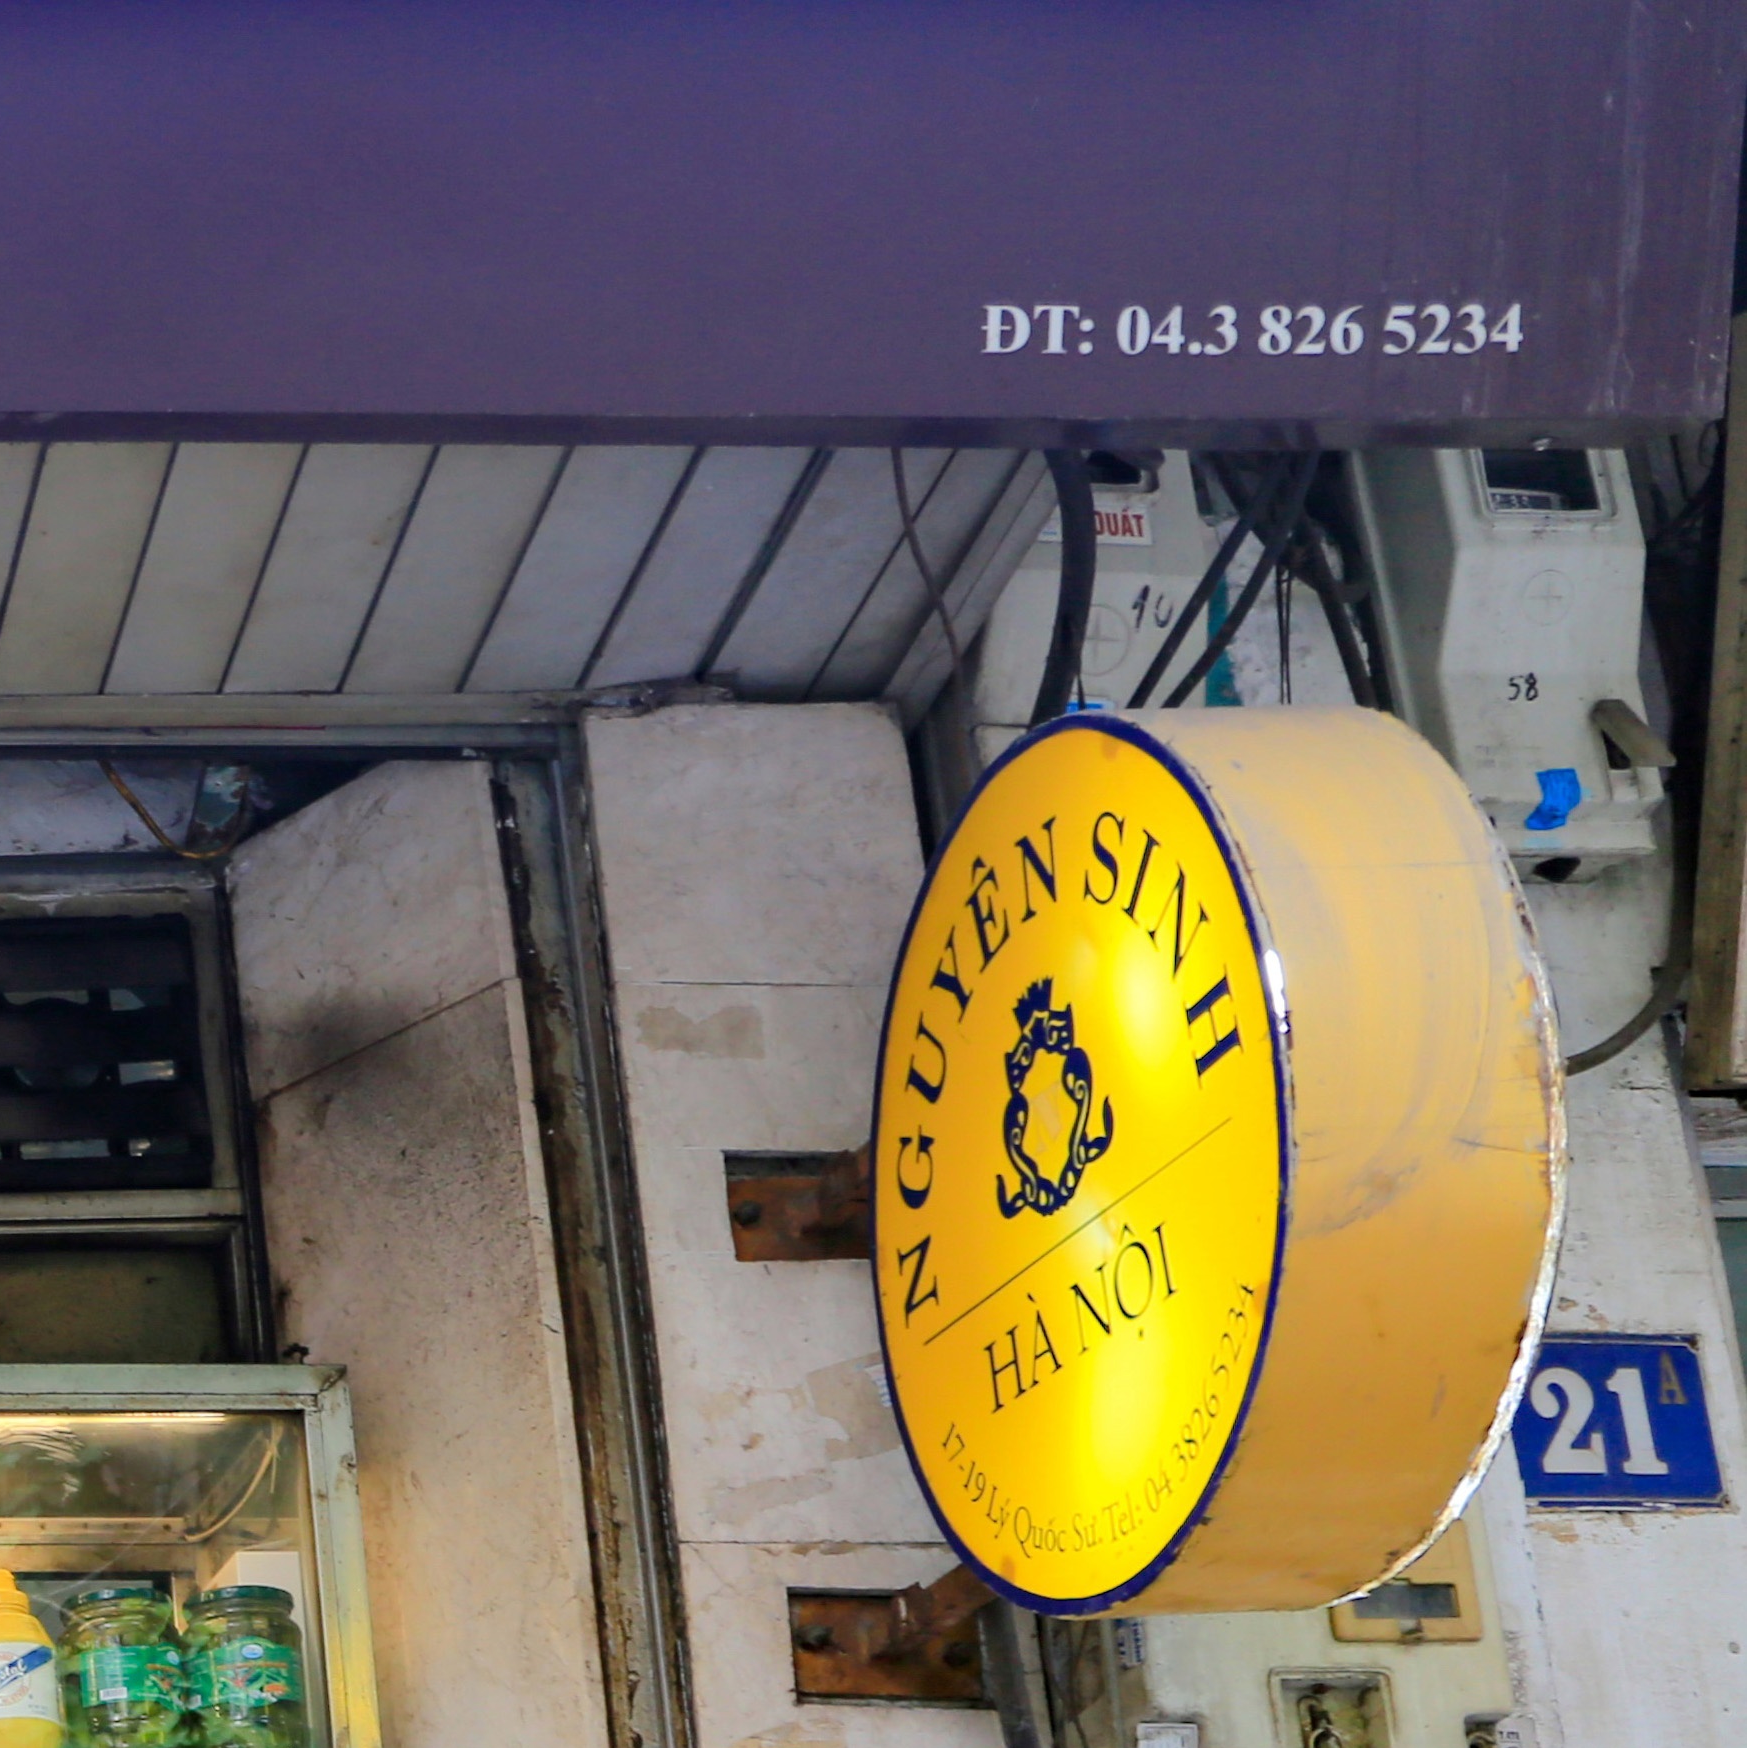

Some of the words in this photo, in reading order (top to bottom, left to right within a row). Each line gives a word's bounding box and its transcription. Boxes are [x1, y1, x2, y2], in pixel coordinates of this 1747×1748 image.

[981, 304, 1097, 355] ĐT:
[1115, 304, 1240, 356] 04.3
[1256, 304, 1365, 356] 826
[1381, 303, 1525, 355] 5234
[1507, 673, 1539, 700] 58
[1082, 811, 1246, 1091] SINH
[983, 1292, 1063, 1414] HÀ
[1069, 1222, 1179, 1357] NỘI
[1530, 1365, 1670, 1475] 21
[985, 1485, 1011, 1540] Lý
[1013, 1504, 1067, 1560] Quốc
[1103, 1490, 1145, 1543] Tel:
[1143, 1465, 1175, 1516] 04
